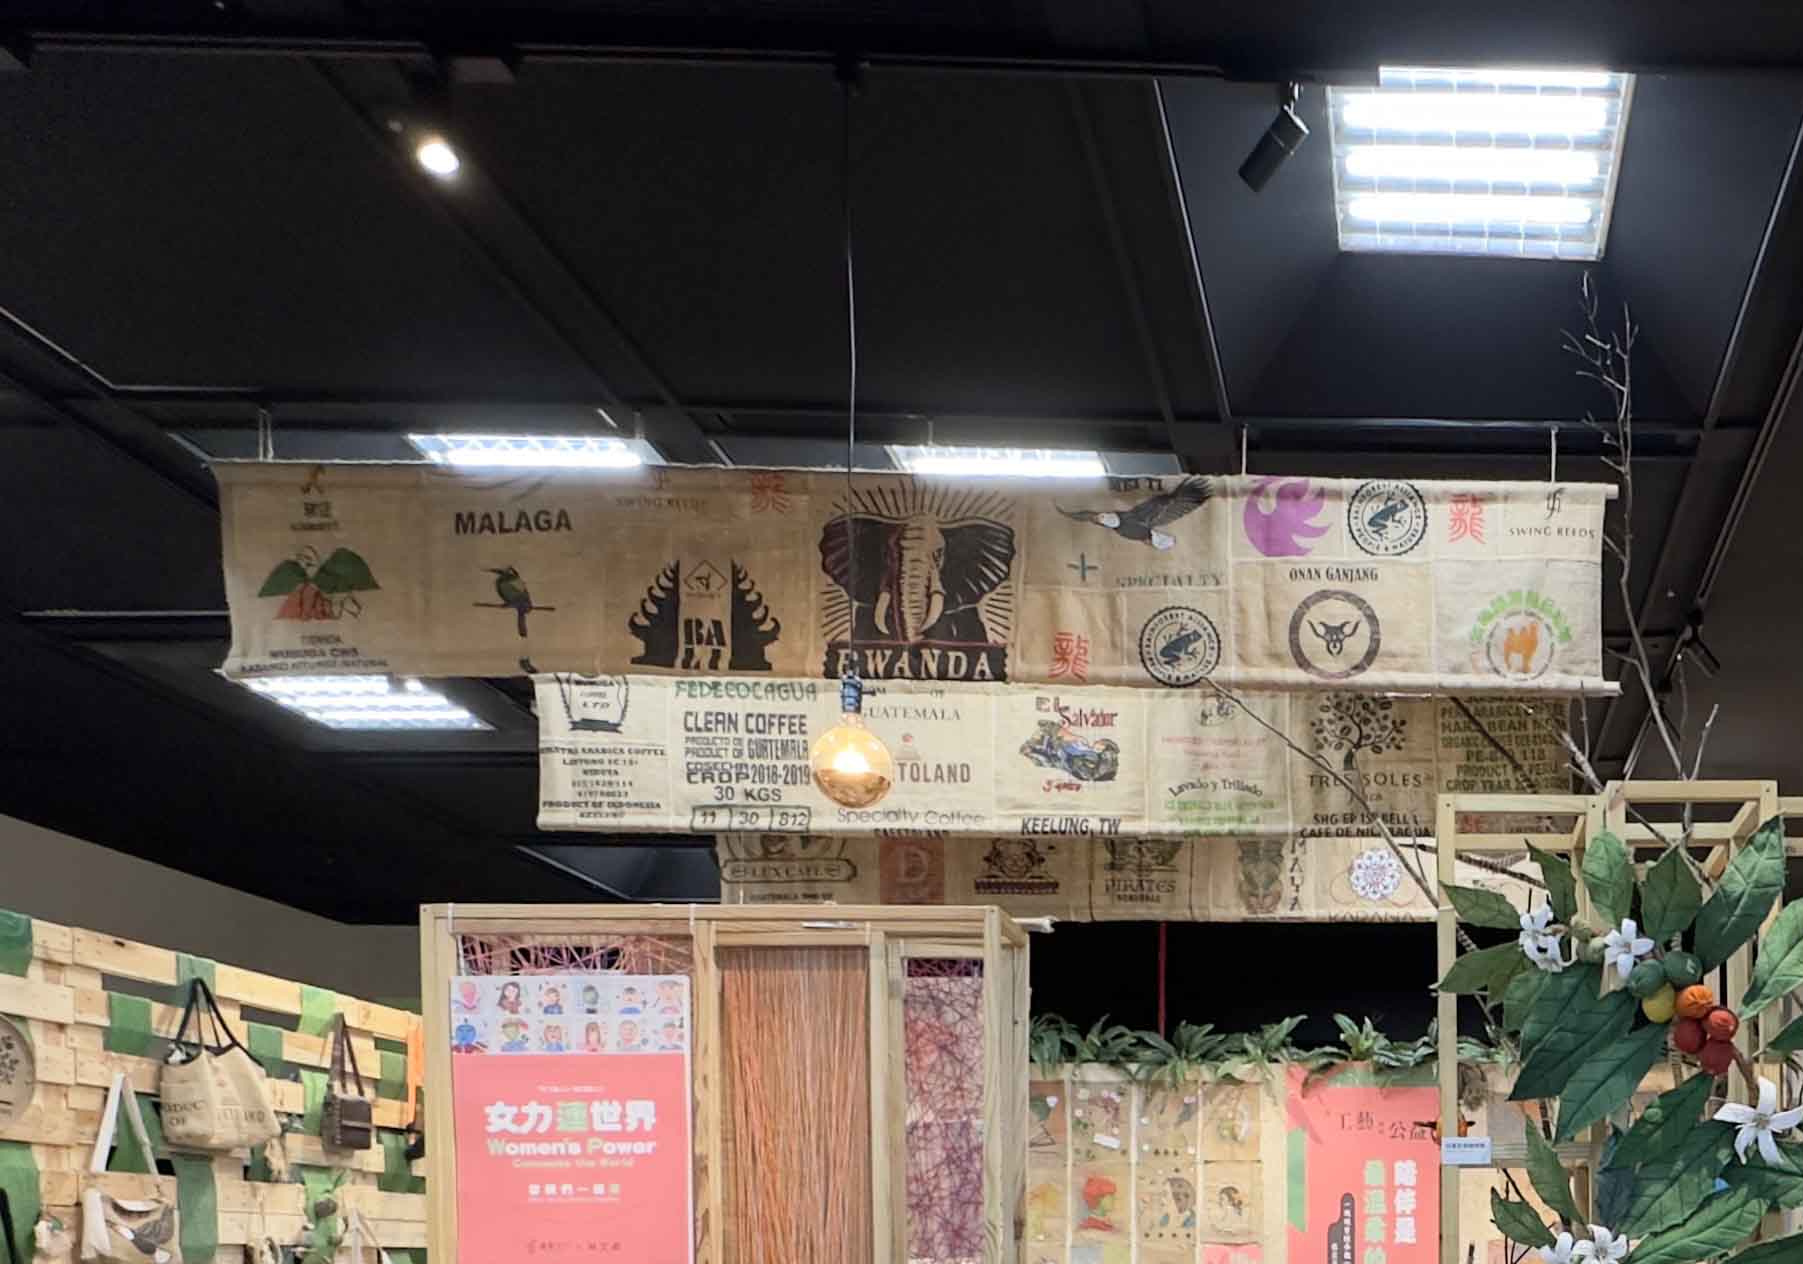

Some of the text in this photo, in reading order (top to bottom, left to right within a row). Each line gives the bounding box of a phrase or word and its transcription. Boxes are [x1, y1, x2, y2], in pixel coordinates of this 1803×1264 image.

[454, 510, 573, 536] MALAGA
[1509, 527, 1552, 537] SWING
[836, 648, 994, 680] RWANDA
[684, 711, 808, 736] CLEAN COFFEE
[1361, 772, 1423, 788] SOLES
[714, 787, 782, 802] 30 KGS
[837, 808, 920, 826] Specialty
[1099, 817, 1121, 834] TW
[484, 1099, 657, 1135] 女力連世界
[587, 1136, 657, 1155] Power
